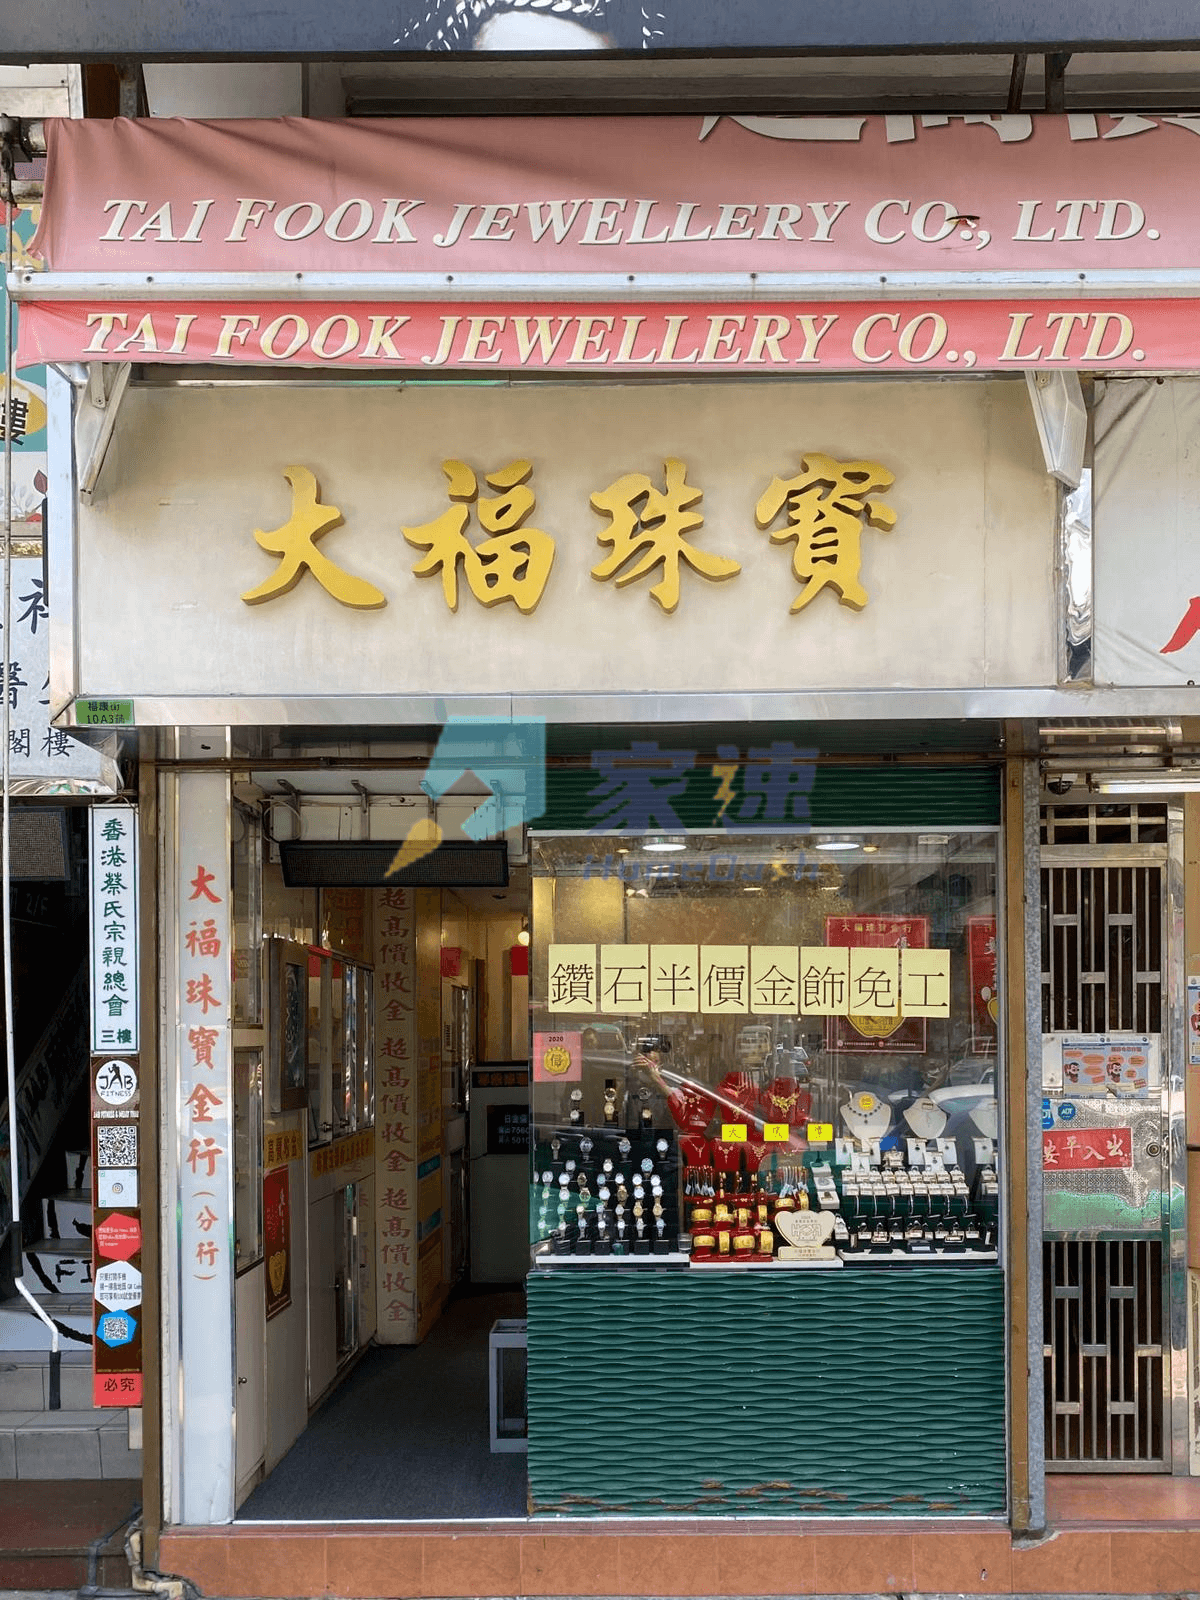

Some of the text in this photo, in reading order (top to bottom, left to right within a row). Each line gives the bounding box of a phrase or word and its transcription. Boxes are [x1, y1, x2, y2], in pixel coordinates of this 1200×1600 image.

[99, 199, 1161, 250] TAI FOOK JEWELLERY CO., LTD.
[82, 312, 1147, 368] TAI FOOK JEWELLERY CO., LTD.
[241, 452, 898, 615] 大福珠寶
[550, 962, 949, 1009] 鑽石半價金飾免工
[100, 1027, 132, 1045] 三樓
[103, 1377, 135, 1392] 必究
